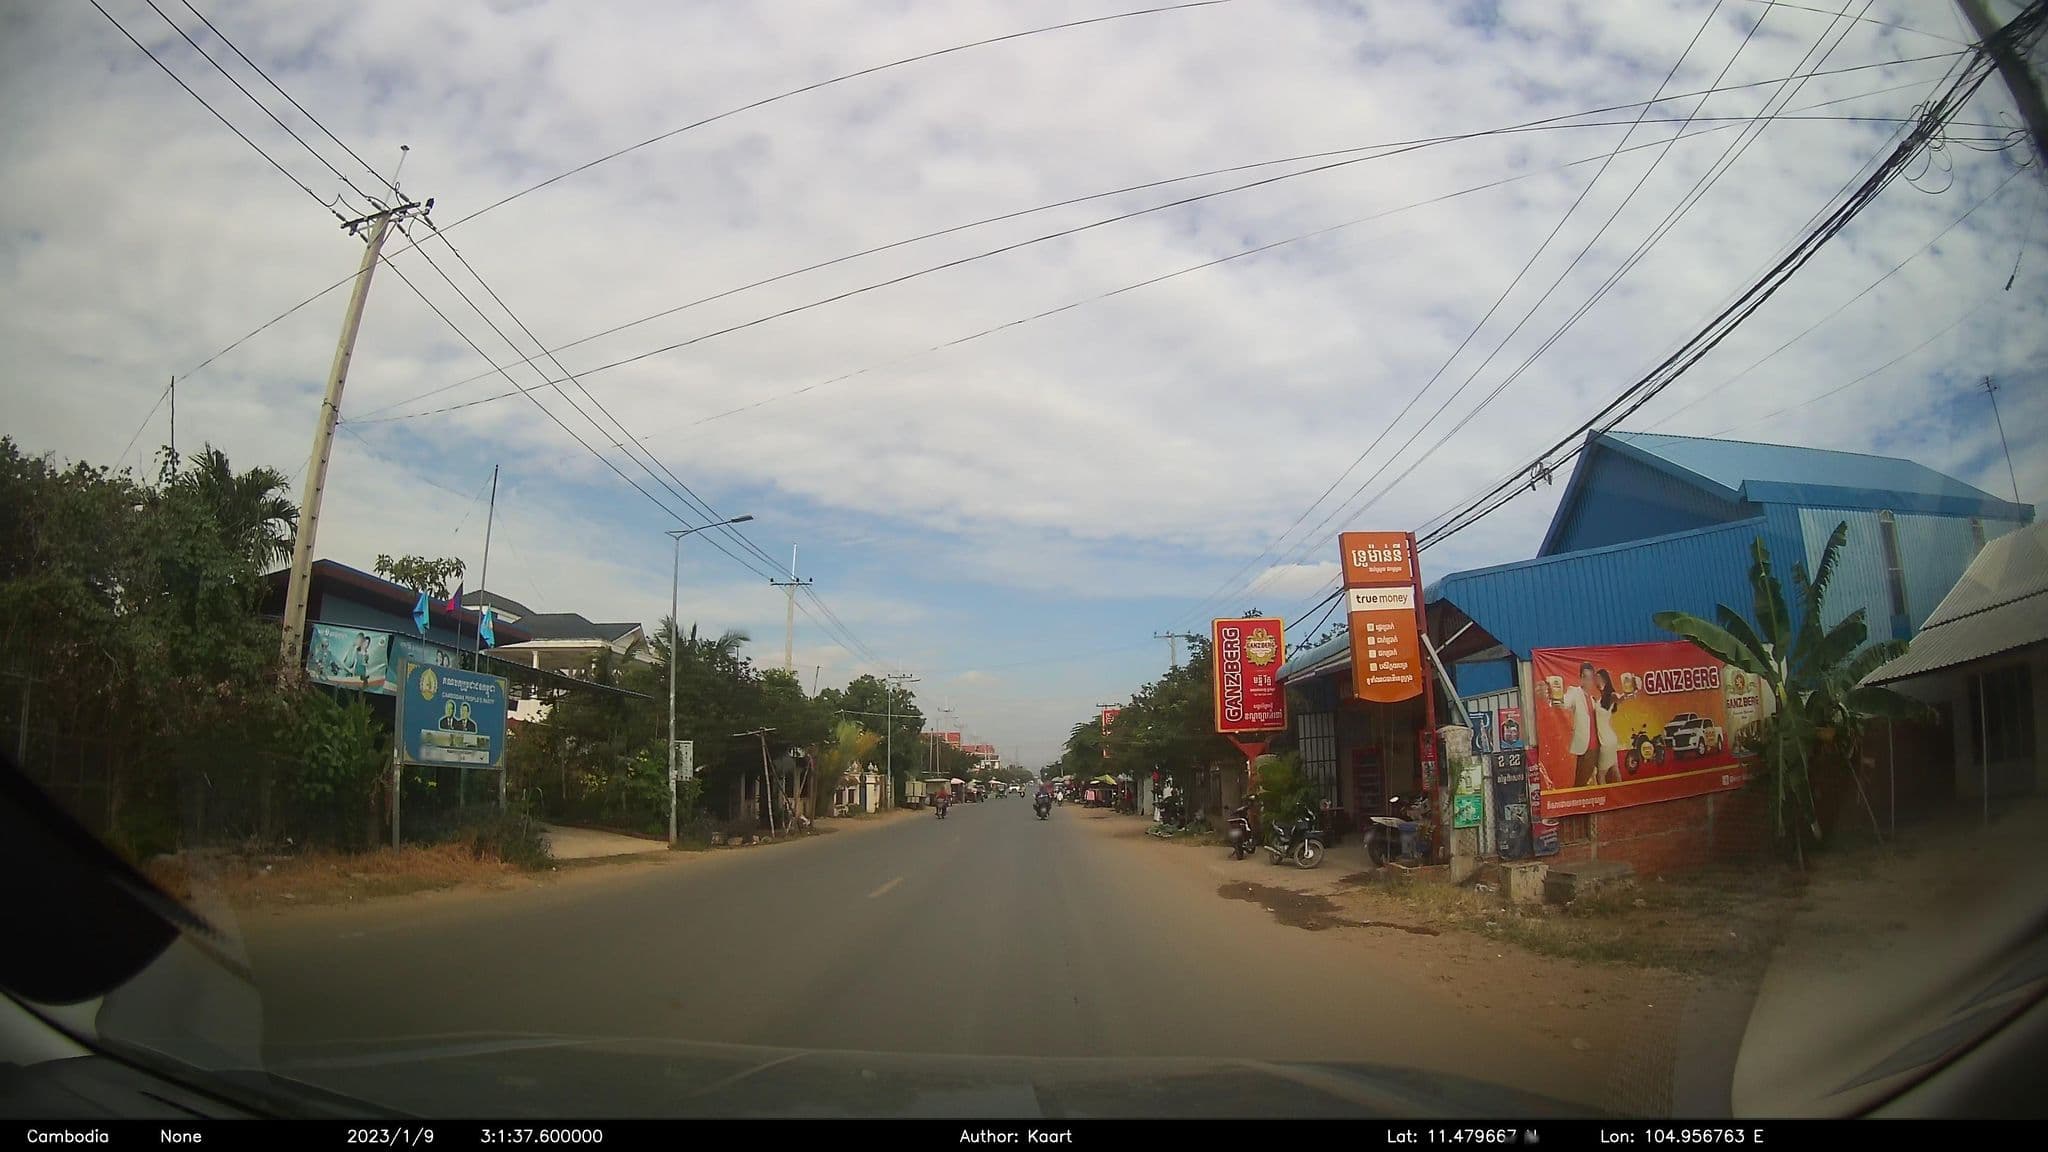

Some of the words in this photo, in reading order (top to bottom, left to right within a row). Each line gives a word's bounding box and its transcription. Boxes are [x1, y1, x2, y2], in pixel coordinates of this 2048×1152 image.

[1356, 594, 1378, 604] true
[1379, 592, 1408, 605] money
[1222, 627, 1243, 721] GANZBERG
[1643, 665, 1721, 695] GANZBERG
